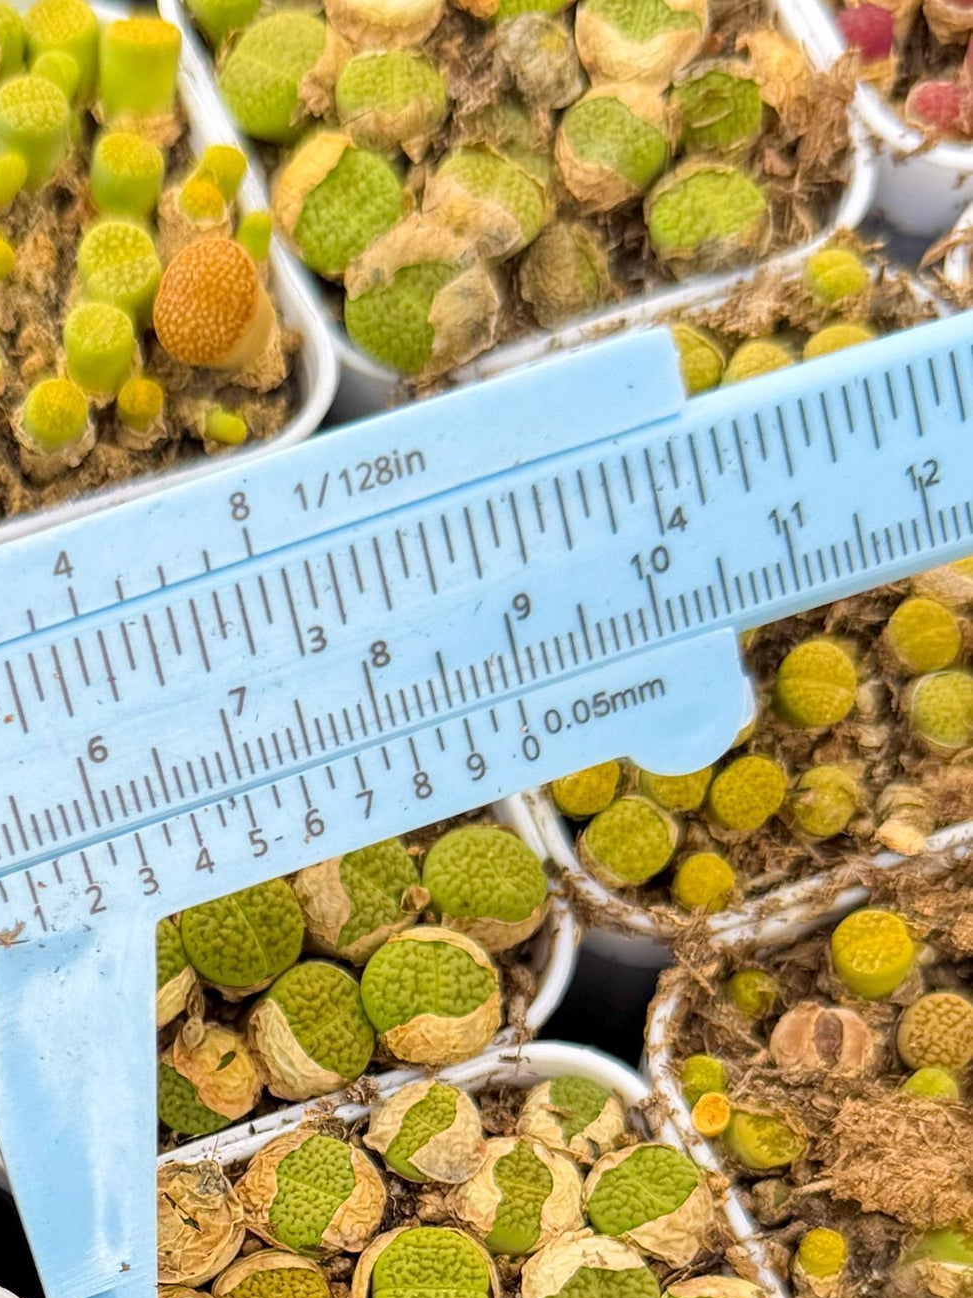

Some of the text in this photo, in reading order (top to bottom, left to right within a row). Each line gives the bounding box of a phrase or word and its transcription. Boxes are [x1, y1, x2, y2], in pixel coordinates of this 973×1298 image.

[53, 551, 74, 578] 4
[230, 492, 250, 521] 8
[293, 450, 426, 511] 1/128in
[87, 735, 109, 763] 6
[228, 686, 246, 716] 7
[369, 640, 391, 668] 8
[512, 593, 531, 620] 9
[630, 545, 670, 580] 10
[768, 501, 803, 535] 11
[905, 459, 940, 491] 12
[306, 626, 327, 653] 3
[667, 506, 688, 532] 4
[34, 905, 47, 931] 1
[84, 885, 107, 915] 2
[138, 867, 159, 896] 3
[195, 847, 215, 874] 4
[247, 828, 268, 857] 5
[305, 808, 326, 838] 6
[355, 790, 373, 819] 7
[413, 771, 433, 800] 8
[466, 752, 486, 781] 9
[522, 734, 541, 762] 0
[543, 677, 666, 735] 0.05mm
